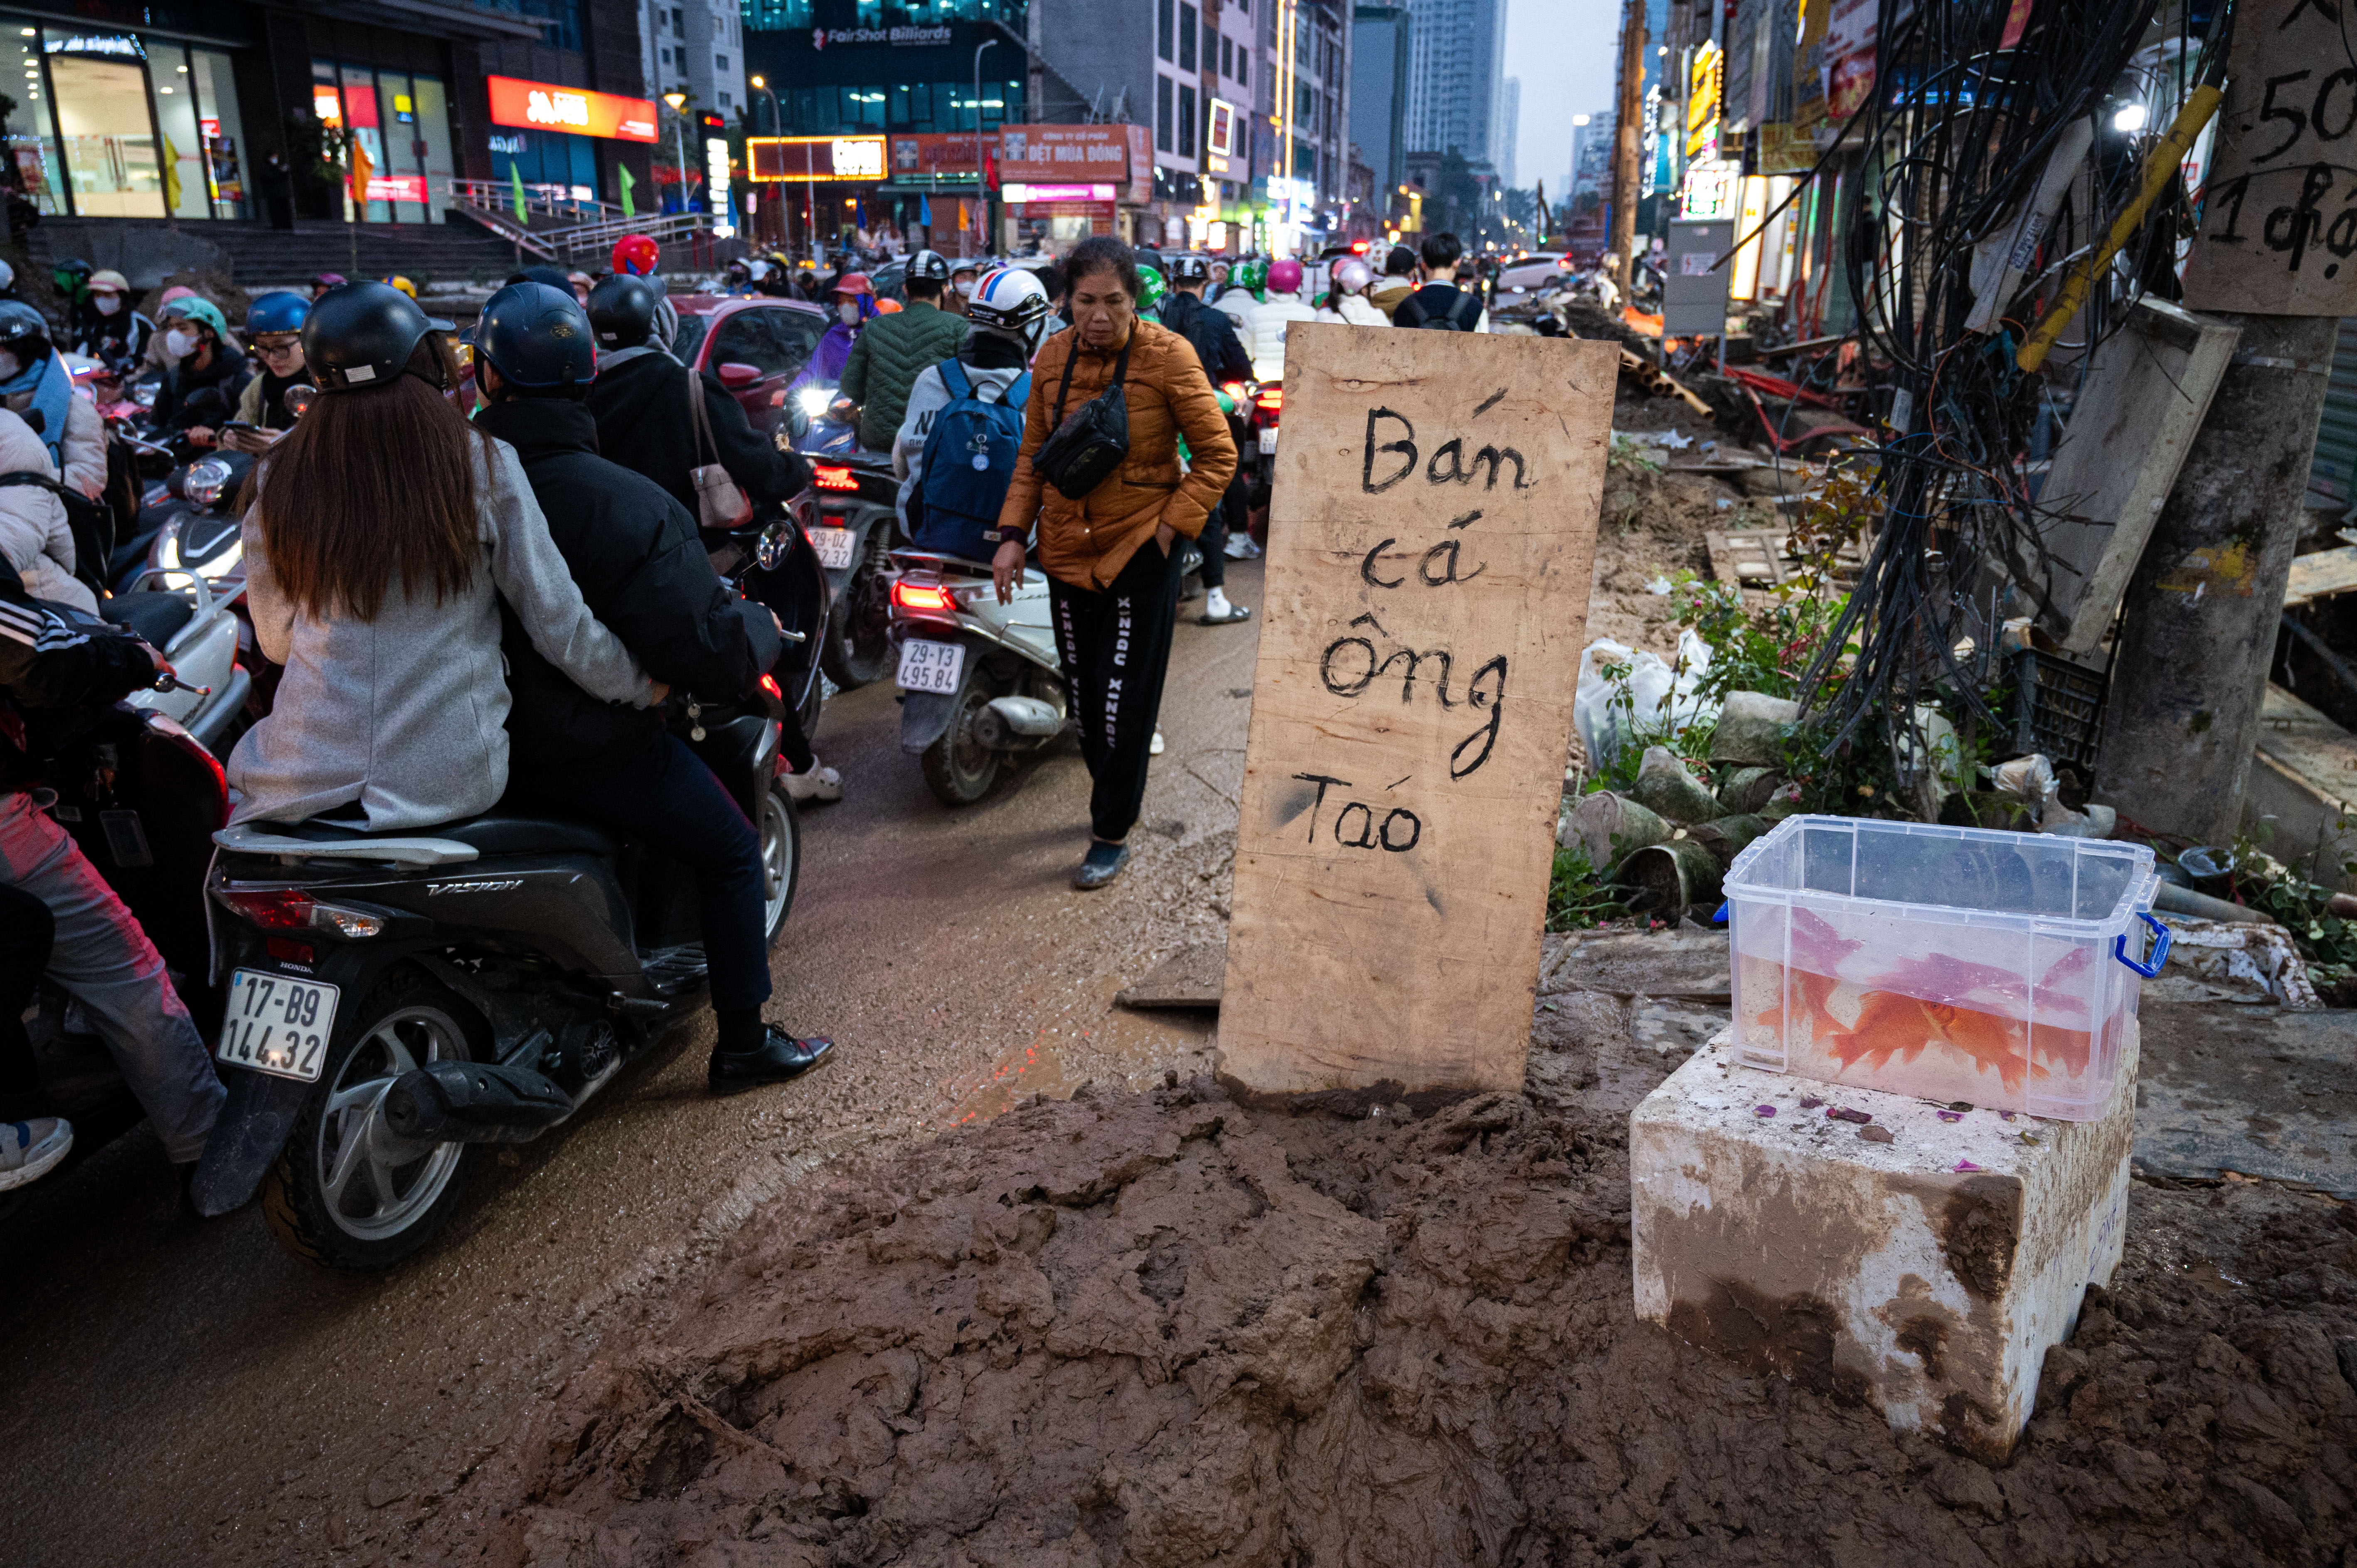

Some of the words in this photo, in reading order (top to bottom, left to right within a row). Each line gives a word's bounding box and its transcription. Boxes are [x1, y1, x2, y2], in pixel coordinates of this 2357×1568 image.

[828, 28, 887, 42] FairShot
[889, 25, 952, 41] Billiards
[913, 409, 938, 435] N
[1362, 387, 1538, 495] Bán
[1360, 509, 1487, 589] cá
[910, 644, 955, 667] 29-Y3
[901, 665, 953, 689] 495.84
[1291, 775, 1421, 852] Táo
[426, 879, 524, 896] VISION
[280, 962, 314, 974] HONDA
[244, 977, 321, 1027] 17-B9
[227, 1019, 320, 1073] 144.32
